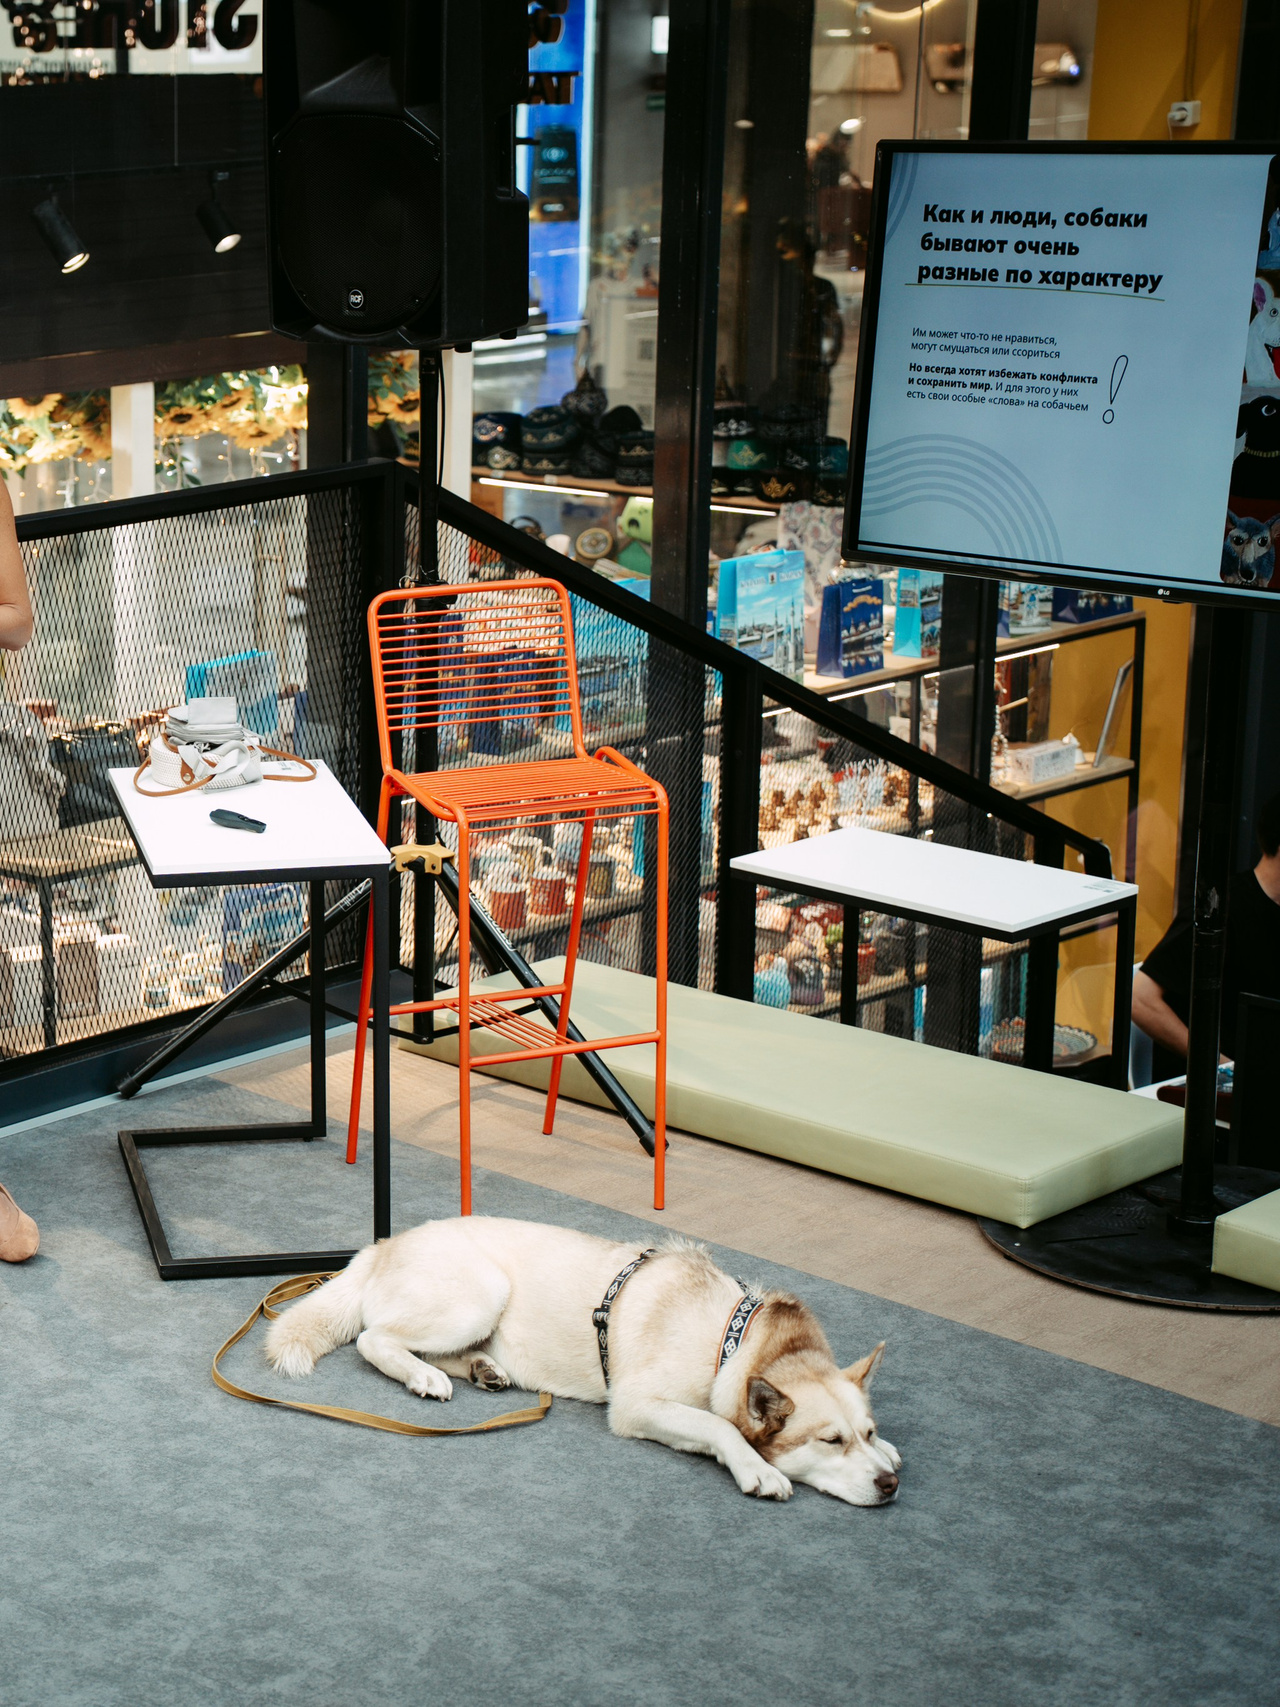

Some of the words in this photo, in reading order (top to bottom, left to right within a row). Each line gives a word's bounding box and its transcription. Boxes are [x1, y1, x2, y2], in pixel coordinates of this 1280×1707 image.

[923, 203, 966, 223] Как
[970, 209, 985, 224] и
[990, 209, 1058, 230] люди,
[1063, 206, 1149, 229] собаки
[920, 231, 1009, 254] бывают
[1013, 239, 1080, 257] очень
[917, 264, 1000, 284] разные
[1005, 268, 1033, 284] по
[1037, 269, 1164, 294] характеру
[912, 327, 927, 338] Им
[928, 330, 959, 340] может
[960, 332, 990, 342] что-то
[991, 334, 1003, 343] не
[1004, 334, 1058, 347] нравиться,
[910, 342, 938, 354] могут
[938, 343, 990, 356] смущаться
[991, 347, 1010, 357] или
[1011, 348, 1061, 360] ссориться
[908, 362, 923, 373] Но
[924, 364, 957, 376] всегда
[958, 367, 987, 377] хотят
[988, 367, 1038, 381] избежать
[1039, 370, 1099, 386] конфликта
[907, 377, 915, 386] и
[916, 377, 968, 391] сохранить
[969, 381, 994, 393] мир.
[995, 382, 1004, 392] И
[1004, 384, 1024, 394] для
[1024, 385, 1051, 396] этого
[1052, 387, 1059, 398] у
[1060, 388, 1080, 398] них
[906, 390, 926, 400] есть
[927, 391, 950, 402] свои
[951, 392, 986, 405] особые
[987, 396, 1026, 408] «слова»
[1027, 399, 1040, 409] на
[1041, 399, 1090, 413] собачьем
